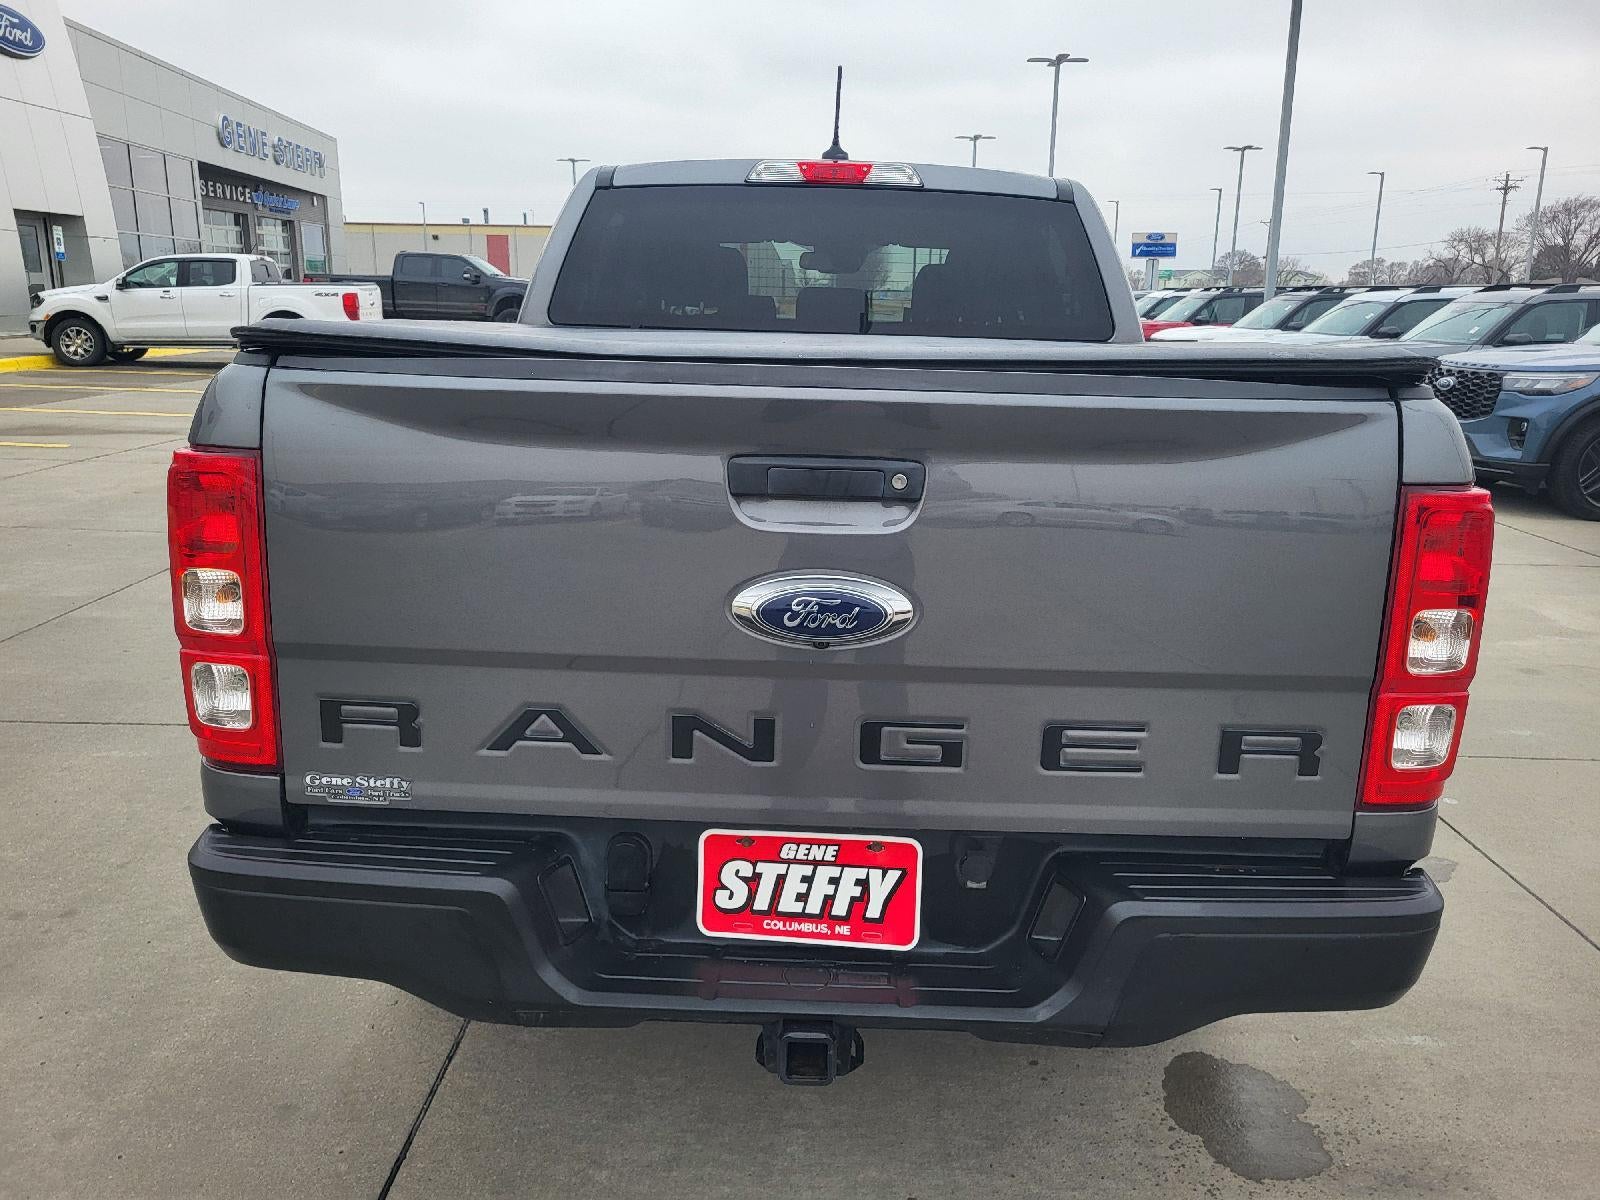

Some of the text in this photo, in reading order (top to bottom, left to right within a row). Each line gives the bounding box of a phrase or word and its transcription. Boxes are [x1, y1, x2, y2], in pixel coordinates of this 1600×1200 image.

[0, 12, 33, 46] Ford
[218, 113, 326, 178] GENE STEFFY
[200, 180, 251, 203] SERVICE
[783, 596, 860, 629] Ford
[319, 698, 1324, 777] RANGER
[305, 774, 410, 790] Gene Steffy
[779, 842, 840, 862] GENE
[713, 858, 906, 922] STEFFY
[763, 919, 851, 935] COLUMBUS, NE
